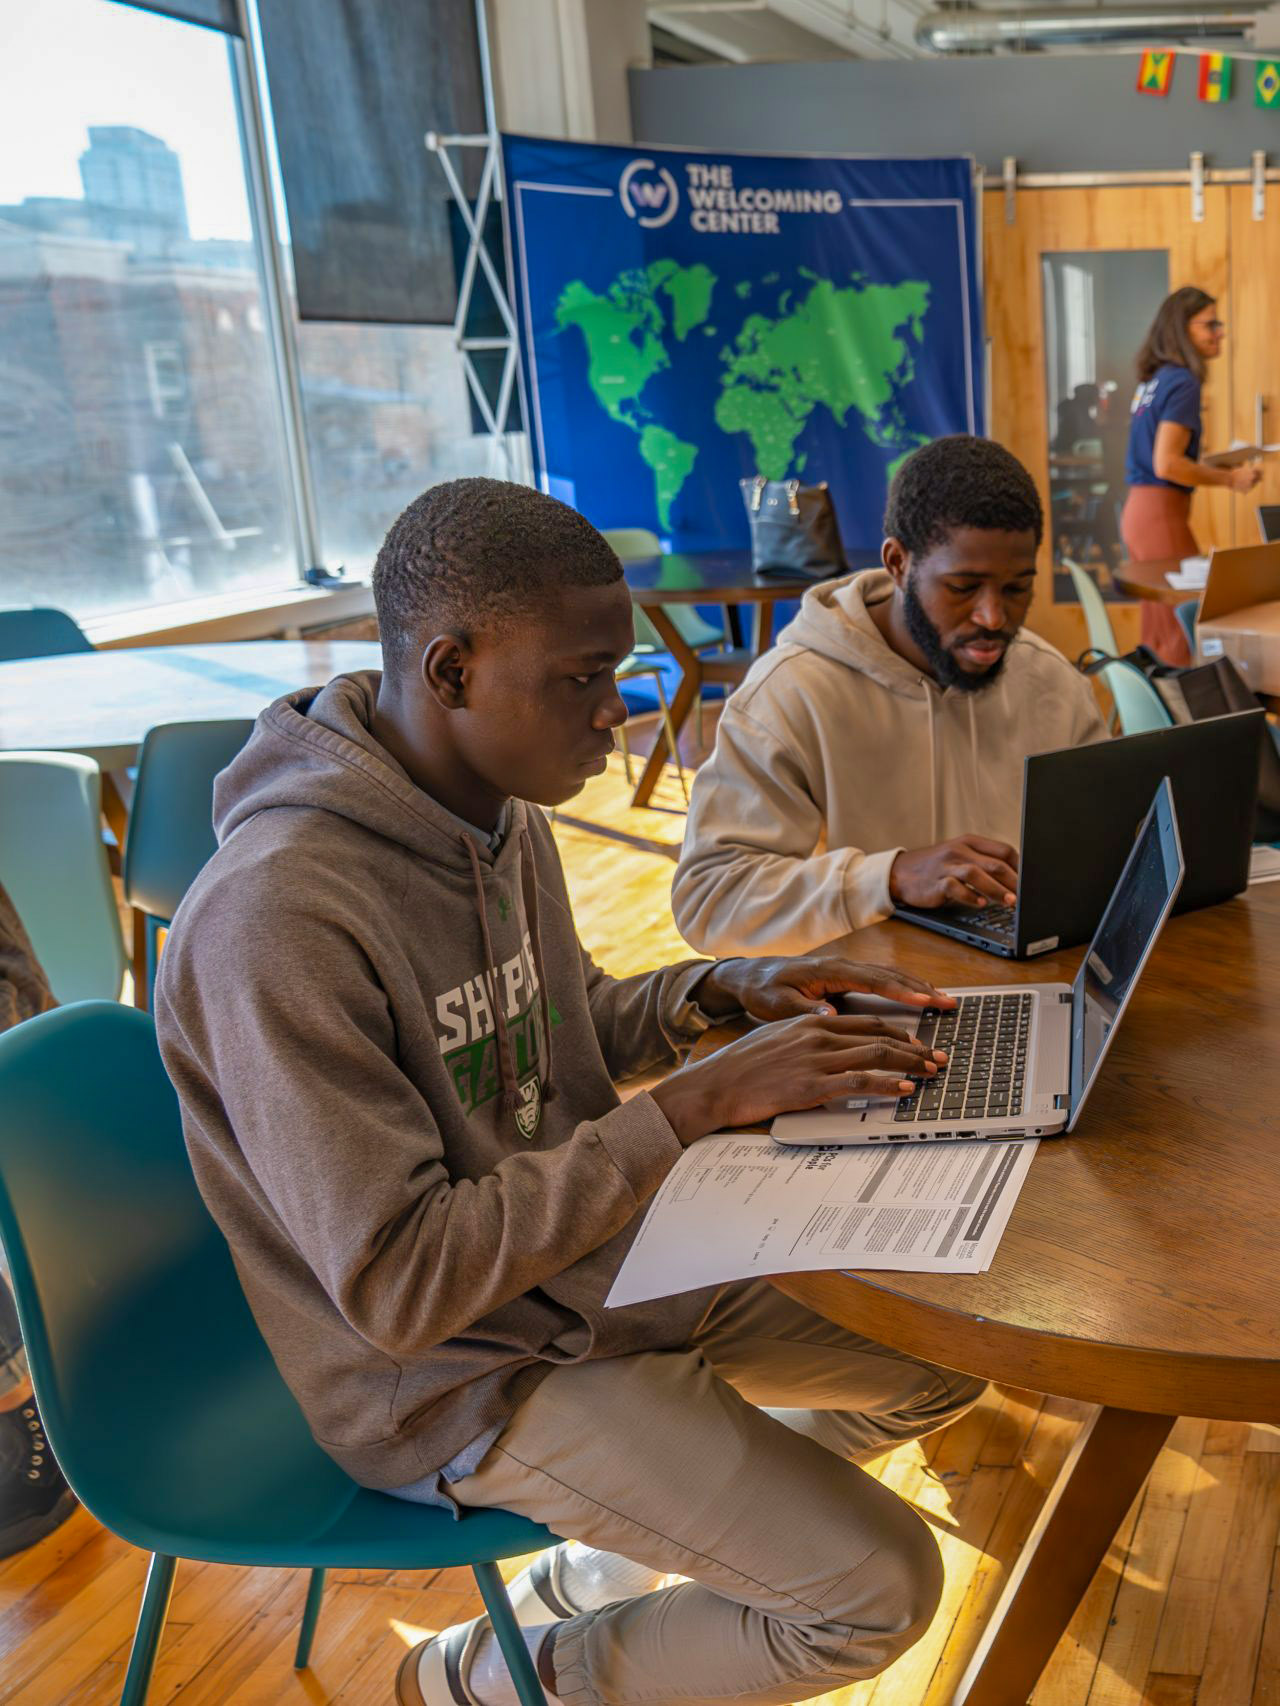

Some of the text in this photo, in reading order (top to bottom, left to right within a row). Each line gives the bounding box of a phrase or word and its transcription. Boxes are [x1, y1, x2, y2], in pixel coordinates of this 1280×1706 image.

[686, 164, 732, 187] THE
[689, 187, 842, 214] WELCOMING
[691, 210, 780, 234] CENTER
[805, 1152, 826, 1170] People
[817, 1152, 838, 1171] PCs for
